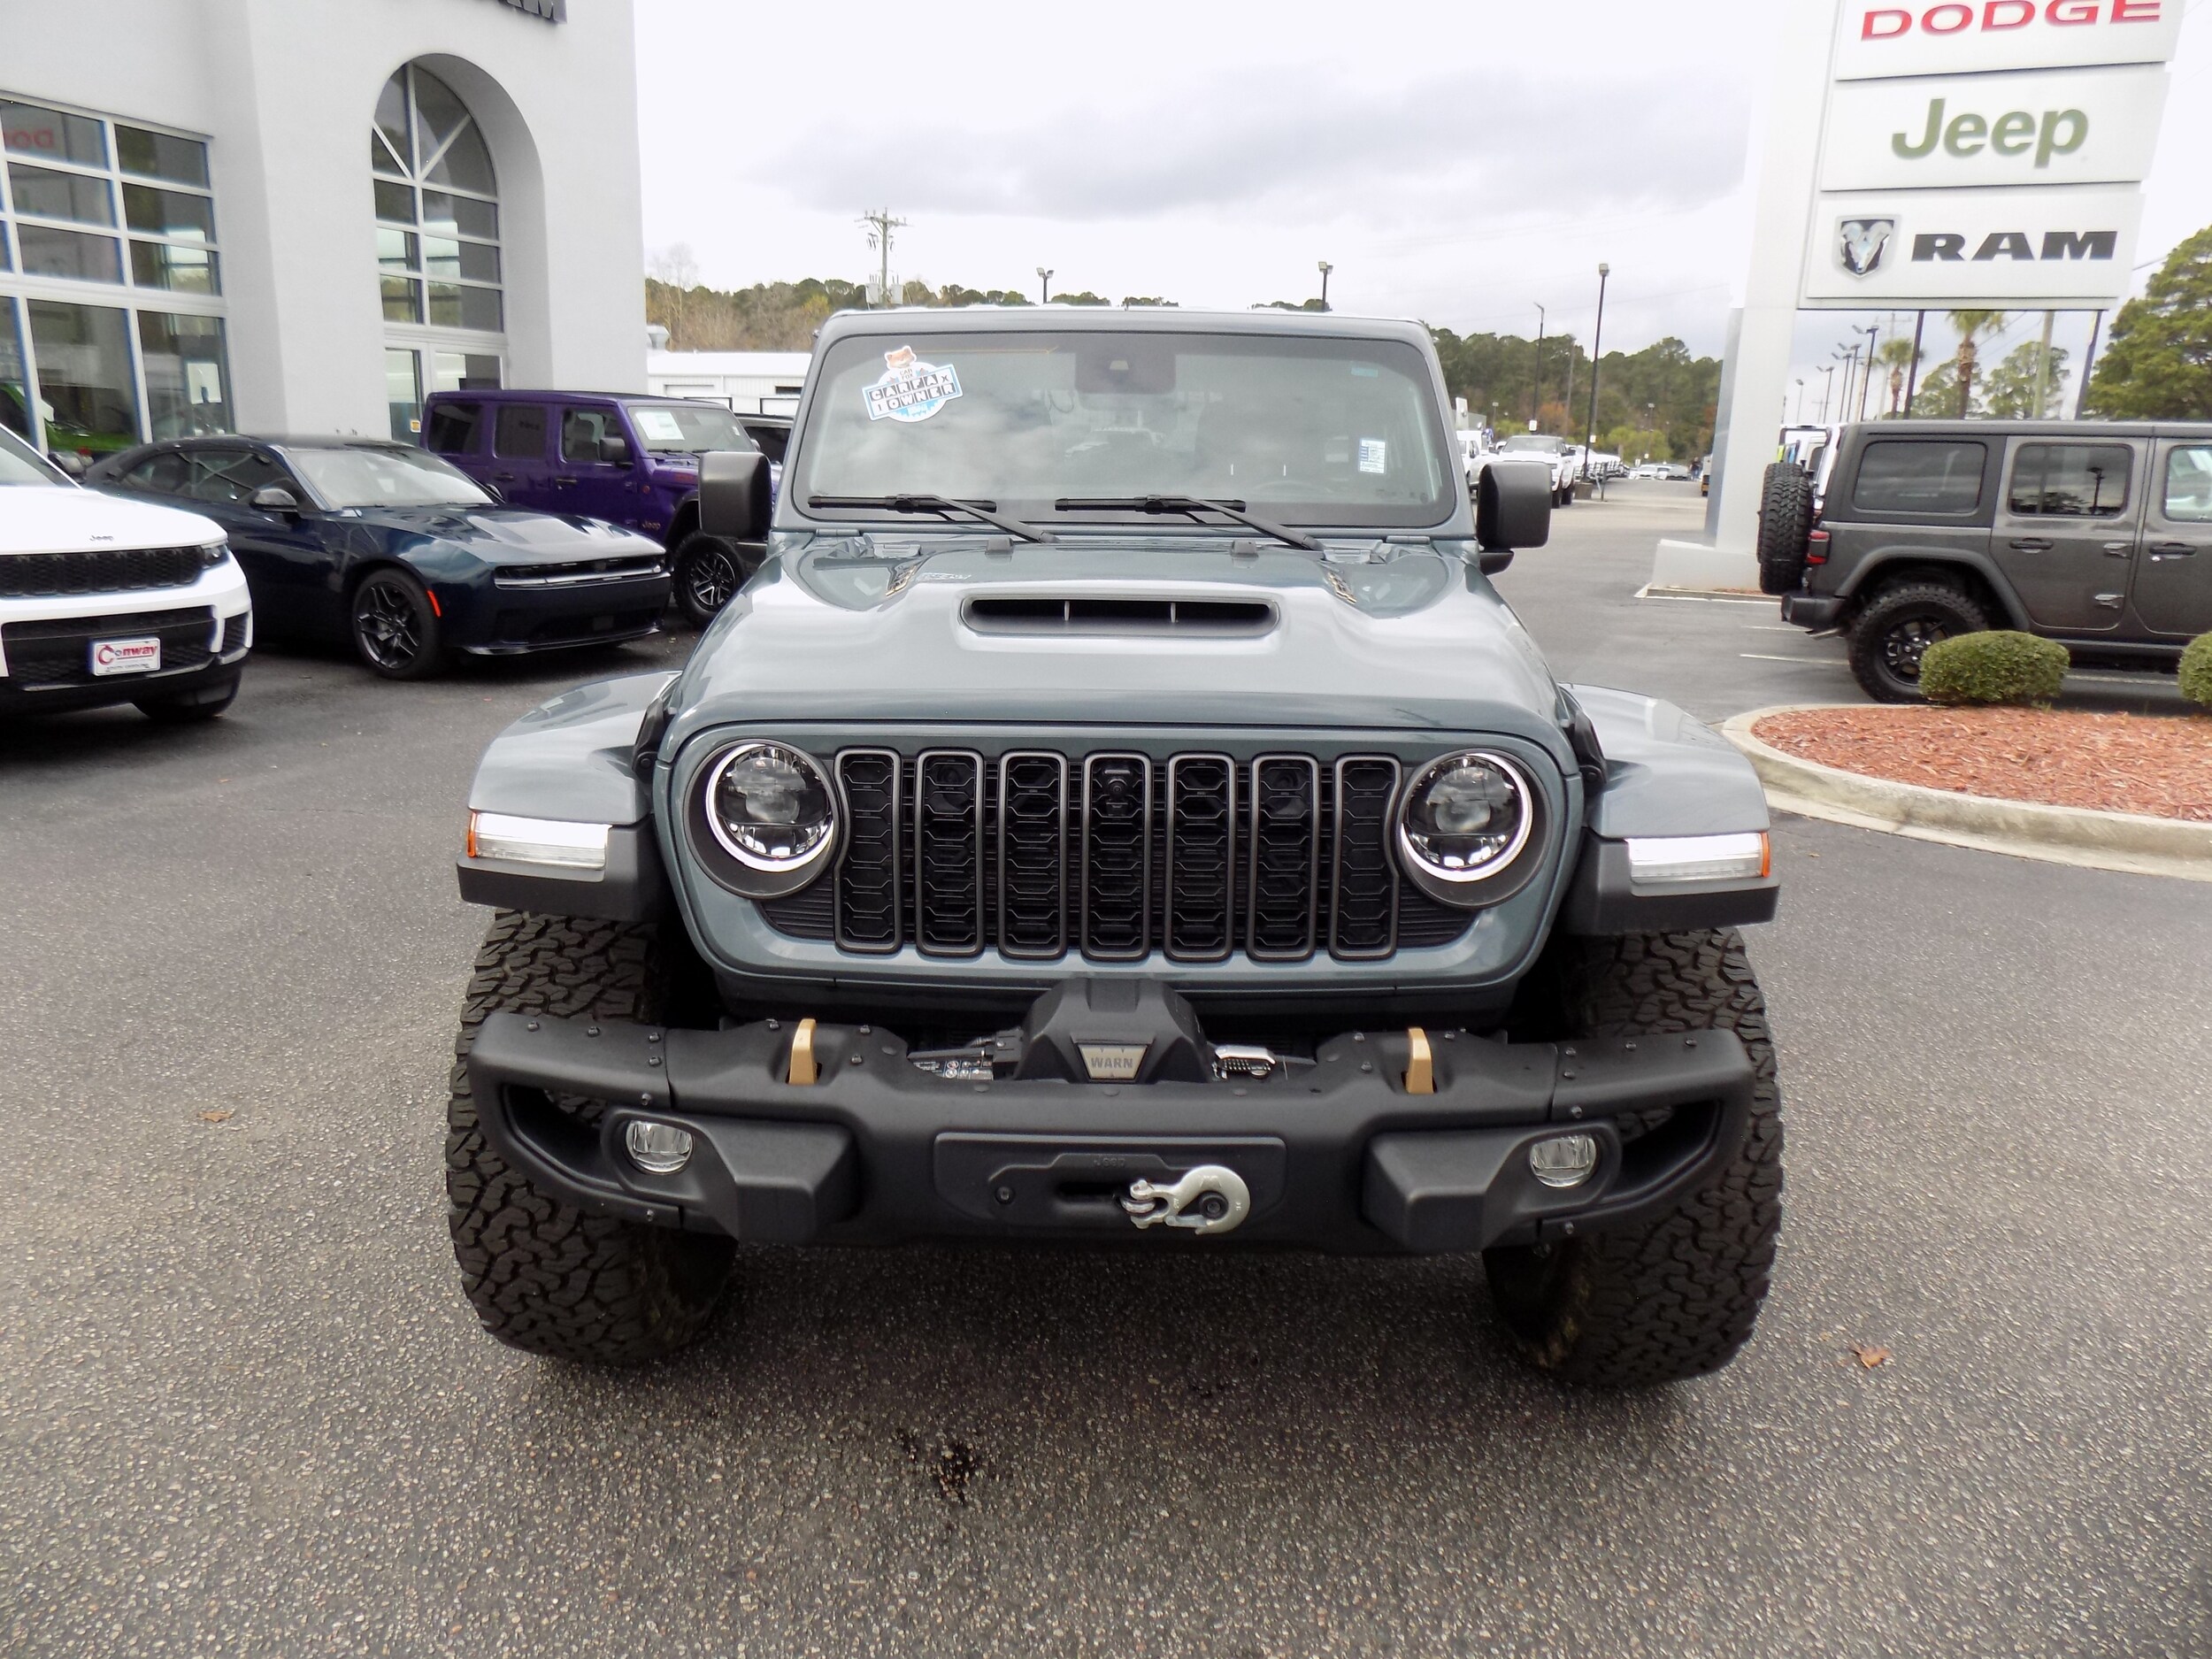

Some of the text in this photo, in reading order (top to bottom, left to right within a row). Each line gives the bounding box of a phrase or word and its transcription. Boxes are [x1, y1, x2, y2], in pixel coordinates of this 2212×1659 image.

[1861, 0, 2161, 41] DODGE
[1892, 97, 2089, 168] Jeep
[1911, 231, 2117, 262] RAM
[869, 373, 949, 401] CARFAX
[642, 520, 661, 530] Jeep
[1091, 1057, 1133, 1069] WARN
